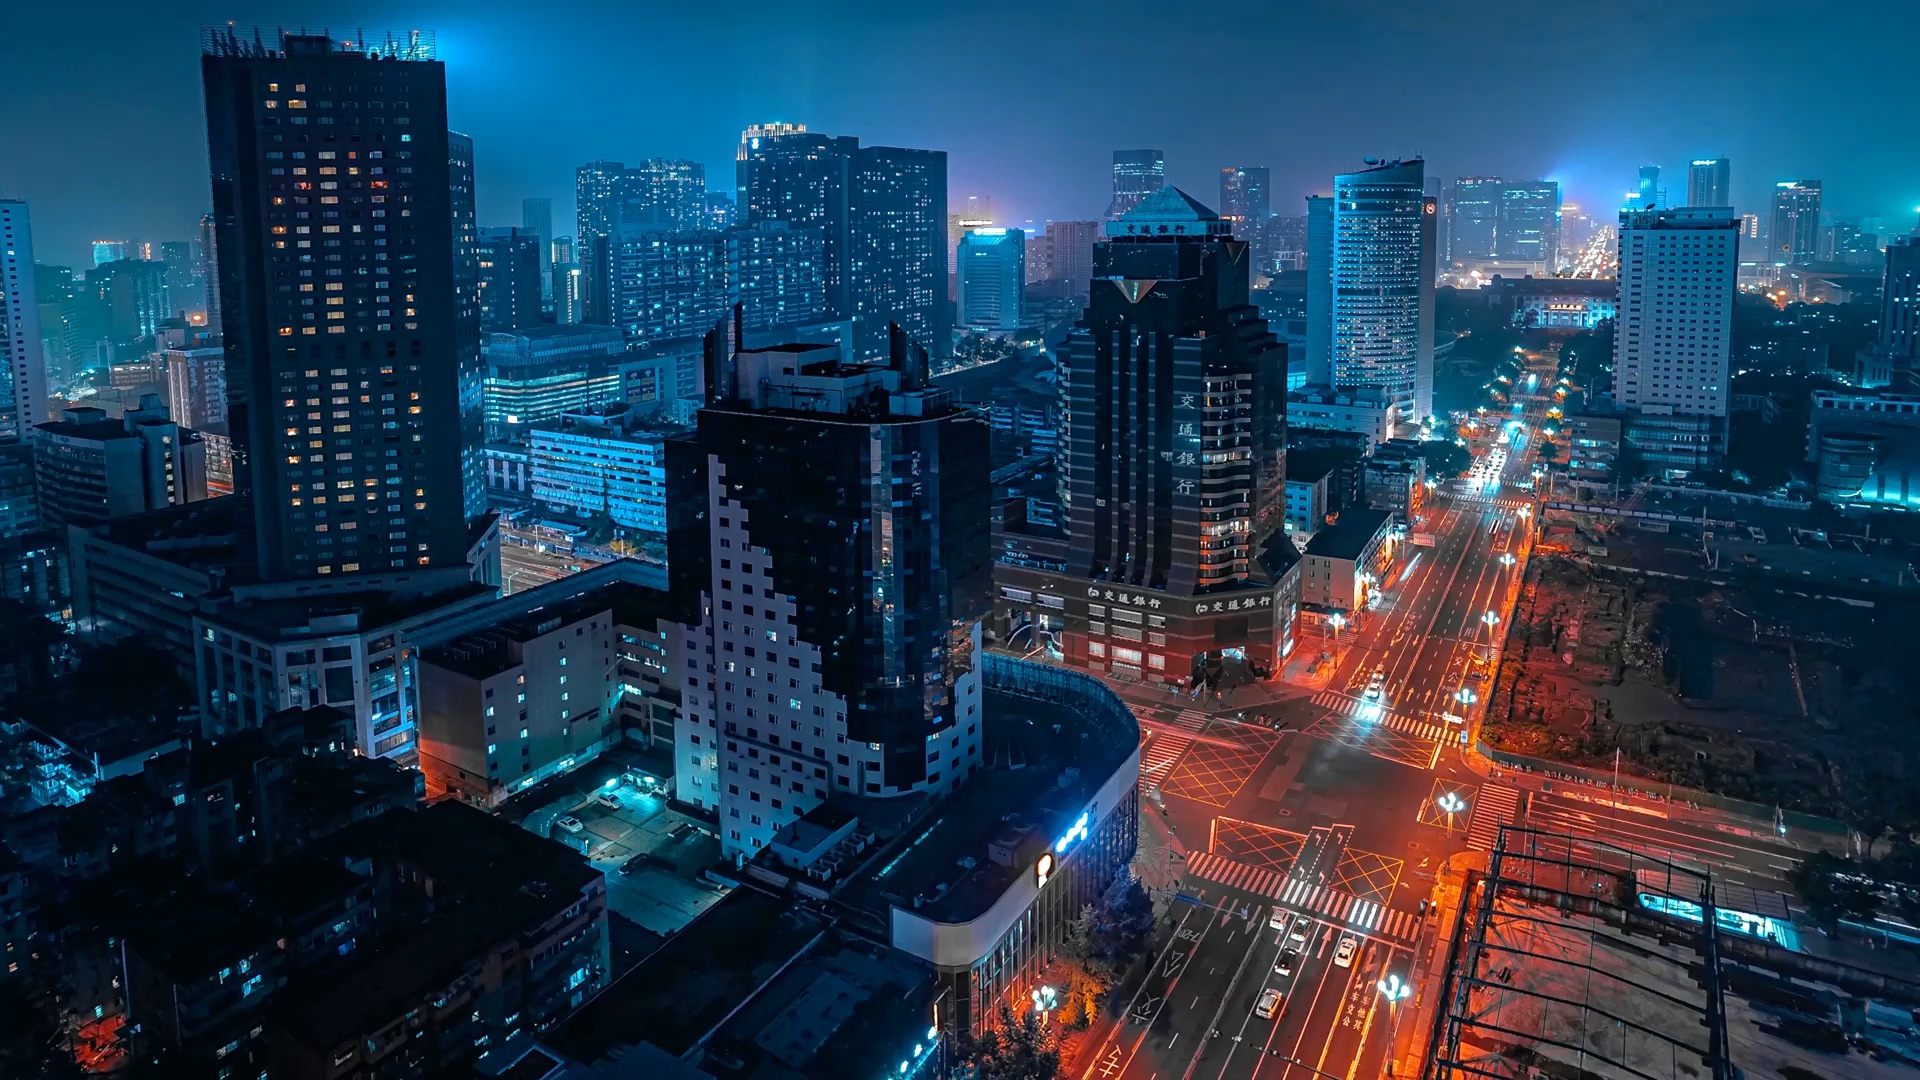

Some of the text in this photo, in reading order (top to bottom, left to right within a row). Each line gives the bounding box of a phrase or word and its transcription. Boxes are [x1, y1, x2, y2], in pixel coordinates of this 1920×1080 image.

[1176, 394, 1200, 495] 交通銀行
[1104, 589, 1162, 609] 交通銀行
[1212, 596, 1272, 612] 交通銀行
